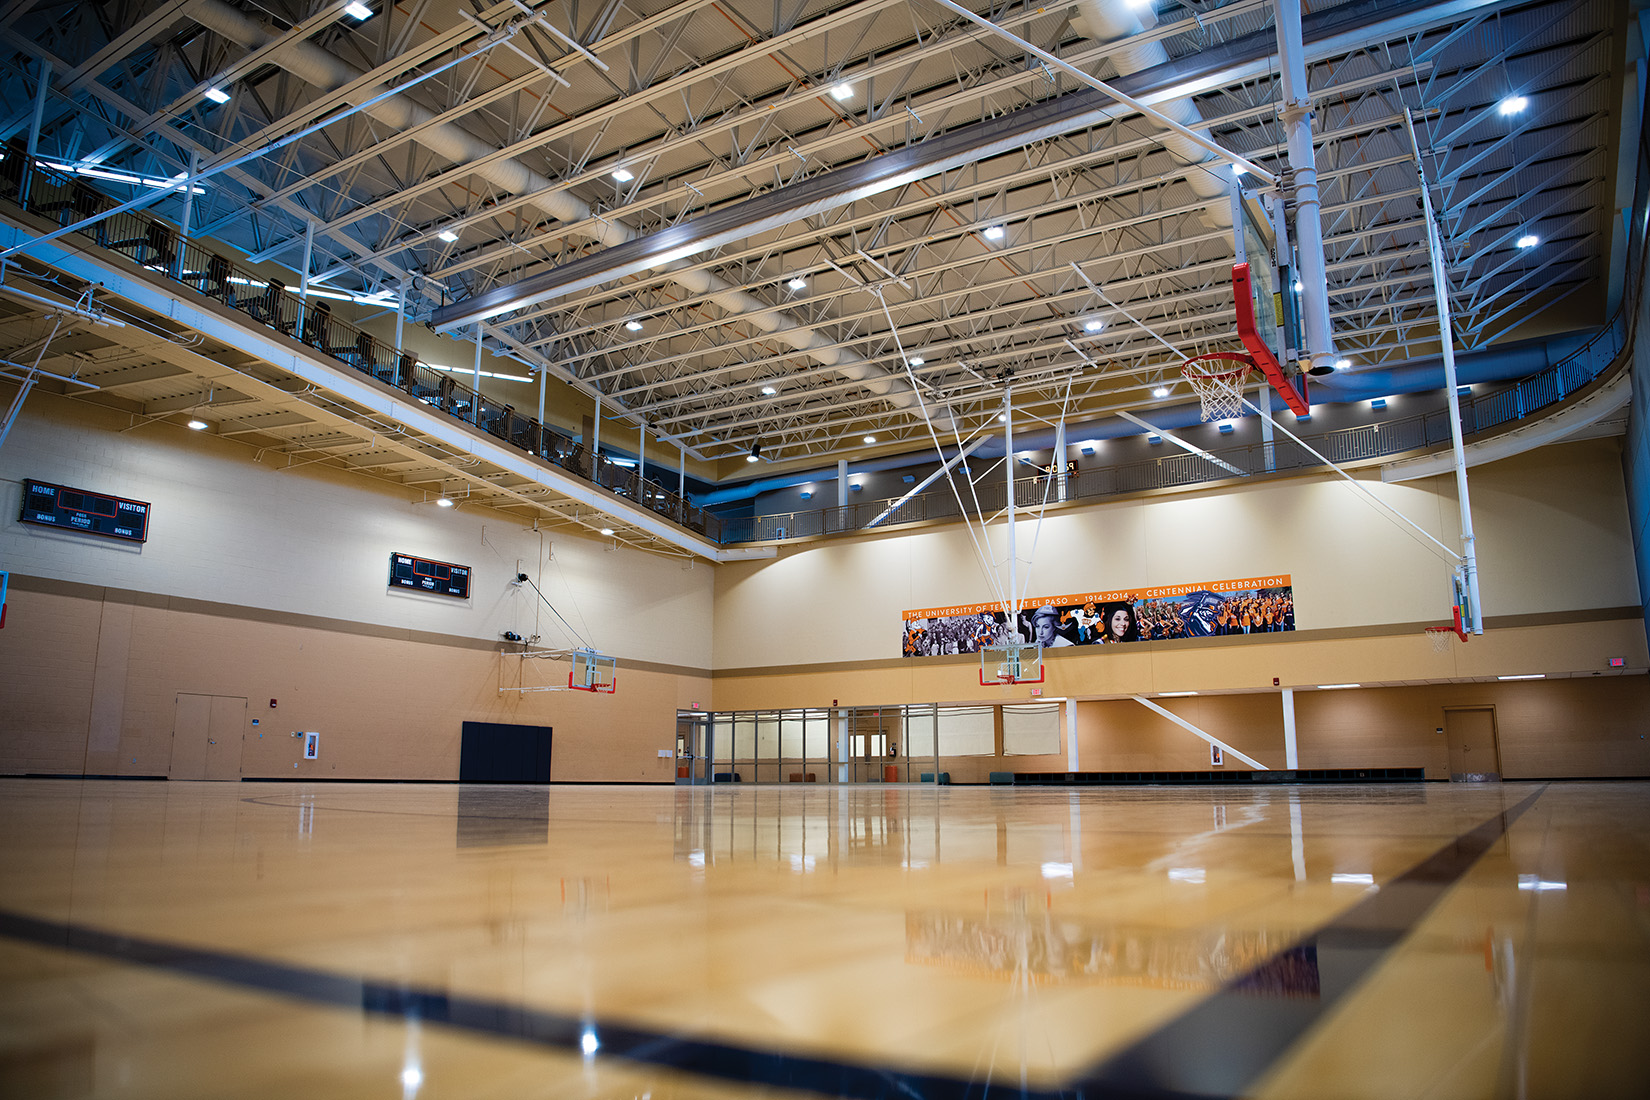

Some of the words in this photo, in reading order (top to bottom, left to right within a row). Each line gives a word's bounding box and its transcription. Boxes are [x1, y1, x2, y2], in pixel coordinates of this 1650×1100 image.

[32, 485, 55, 496] HOME
[118, 502, 146, 513] VISITOR
[36, 513, 56, 522] BONUS
[71, 516, 91, 525] PERIOD
[114, 528, 132, 536] BONUS
[398, 557, 412, 565] HOME
[451, 567, 468, 576] VISITOR
[925, 606, 973, 617] UNIVERSITY
[975, 604, 987, 612] OF
[1032, 599, 1042, 607] EL
[1045, 596, 1068, 606] PASO
[1084, 592, 1128, 602] 1914-2014
[1146, 585, 1206, 597] CENTENNIAL
[1212, 578, 1283, 591] CELEBRATION
